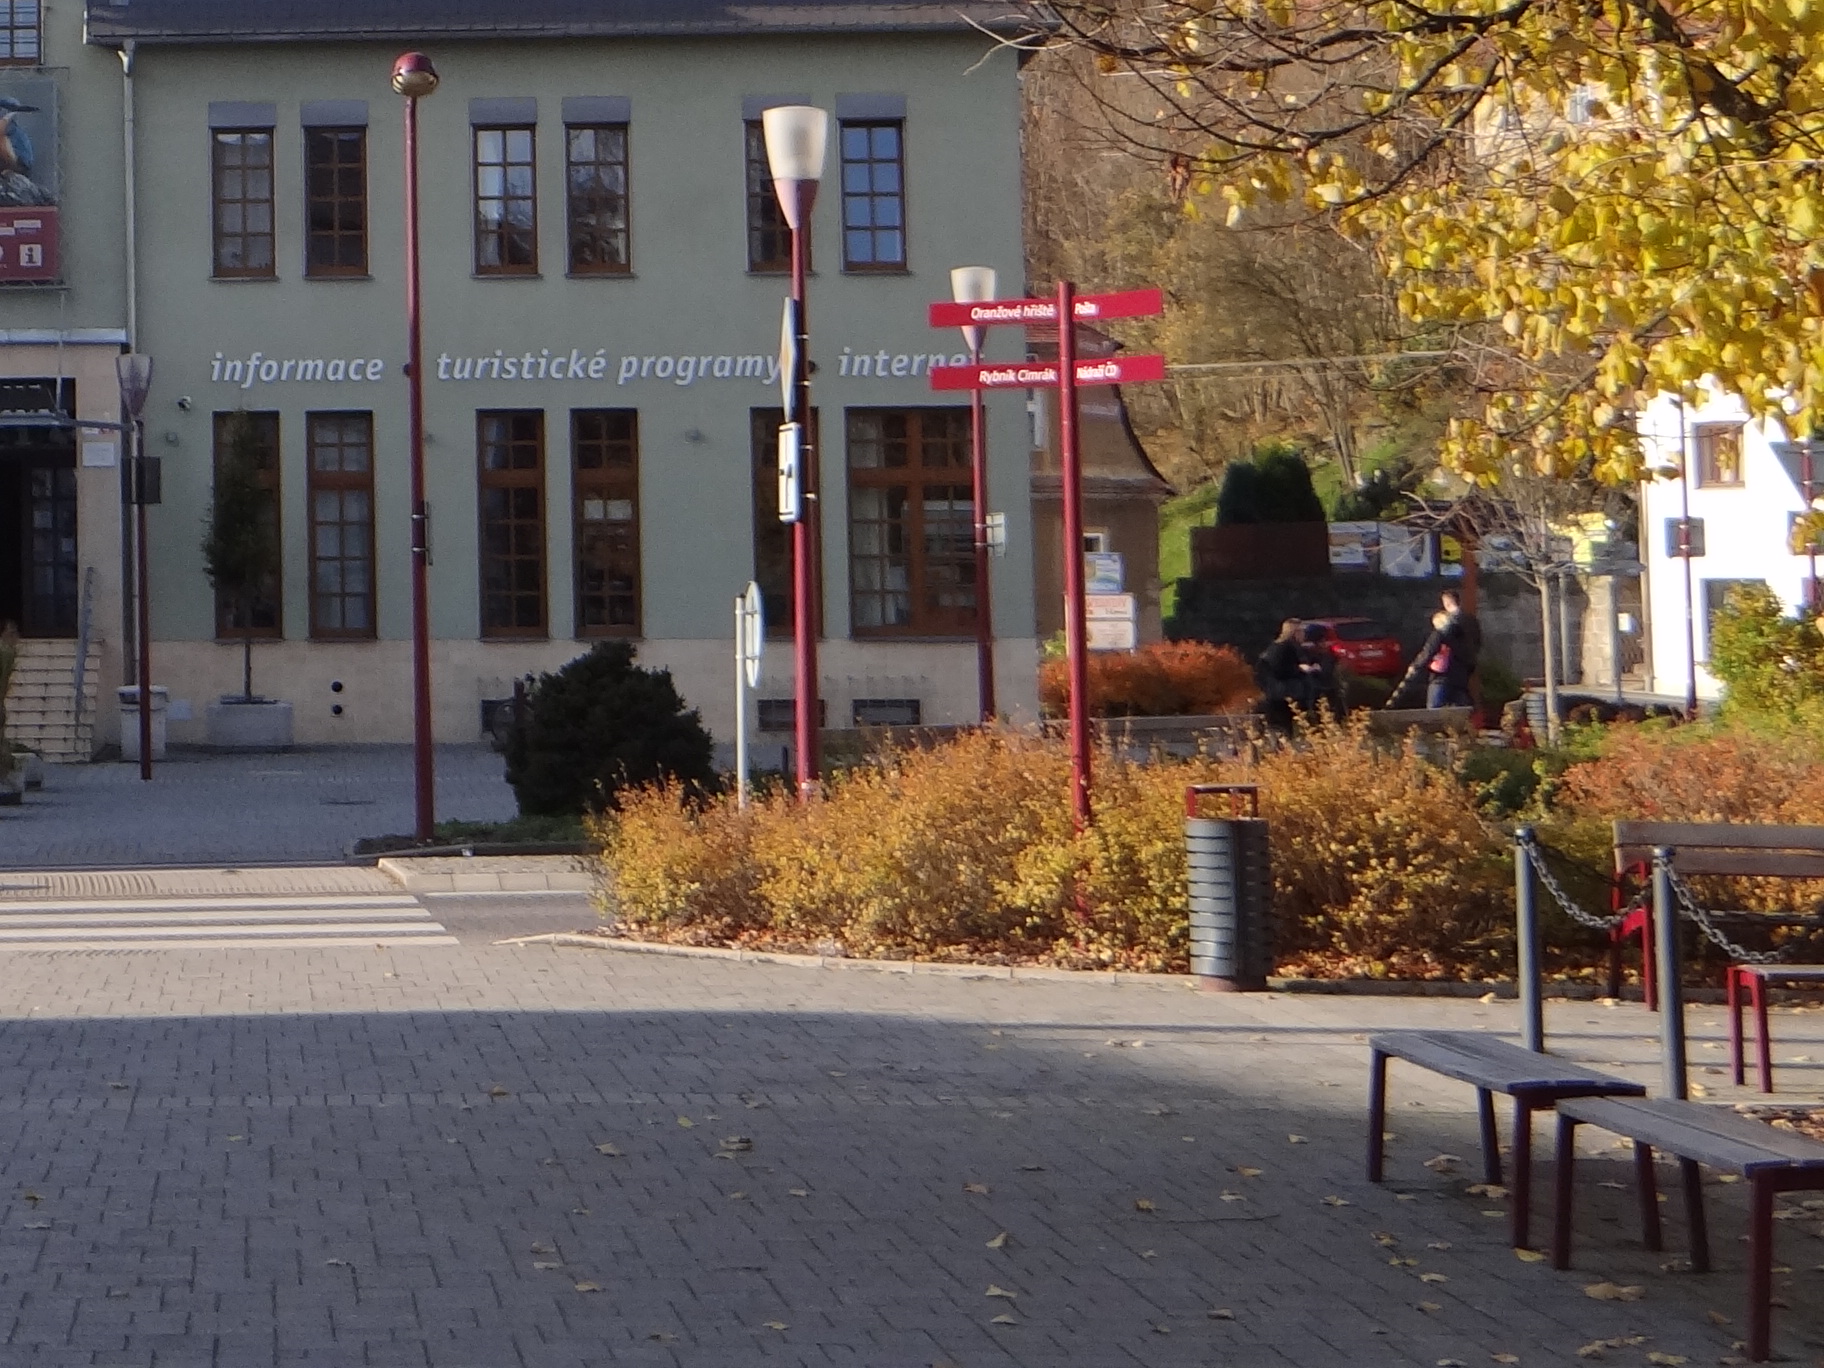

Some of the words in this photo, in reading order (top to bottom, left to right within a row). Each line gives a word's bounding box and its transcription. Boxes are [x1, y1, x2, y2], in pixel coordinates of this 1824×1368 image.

[970, 304, 1021, 320] Oranžové
[1023, 303, 1054, 317] hřiště
[210, 352, 384, 389] informace
[436, 347, 607, 380] turistické
[616, 354, 782, 385] programy
[979, 369, 1015, 384] Rybník
[1017, 368, 1056, 381] Cimrák
